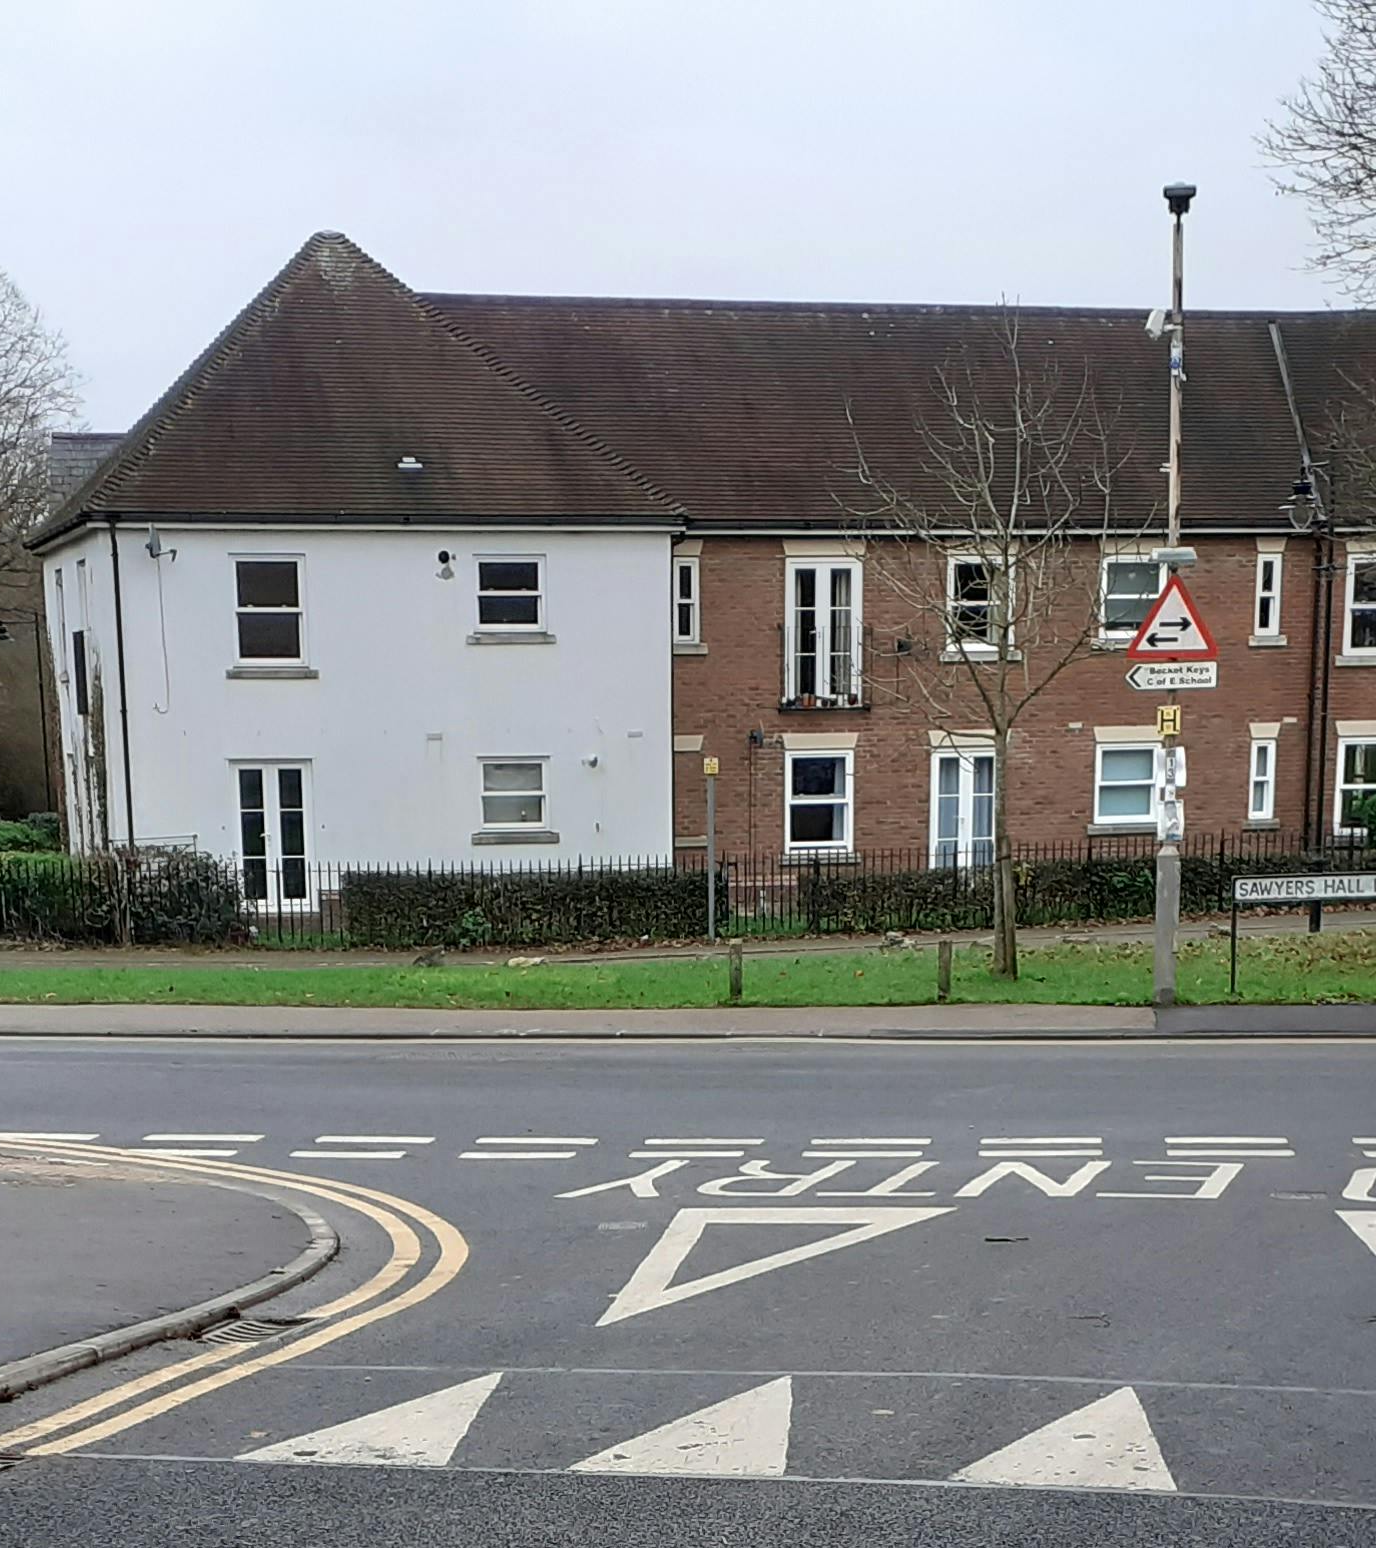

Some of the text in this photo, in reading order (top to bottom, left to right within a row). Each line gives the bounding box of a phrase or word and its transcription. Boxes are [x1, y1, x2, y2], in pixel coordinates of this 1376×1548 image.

[1149, 665, 1210, 675] Becket Keys
[1156, 677, 1166, 685] of
[1179, 676, 1212, 685] School
[1238, 880, 1315, 897] SAWYERS
[1324, 878, 1365, 894] HALL
[552, 1156, 1246, 1202] ENTRY
